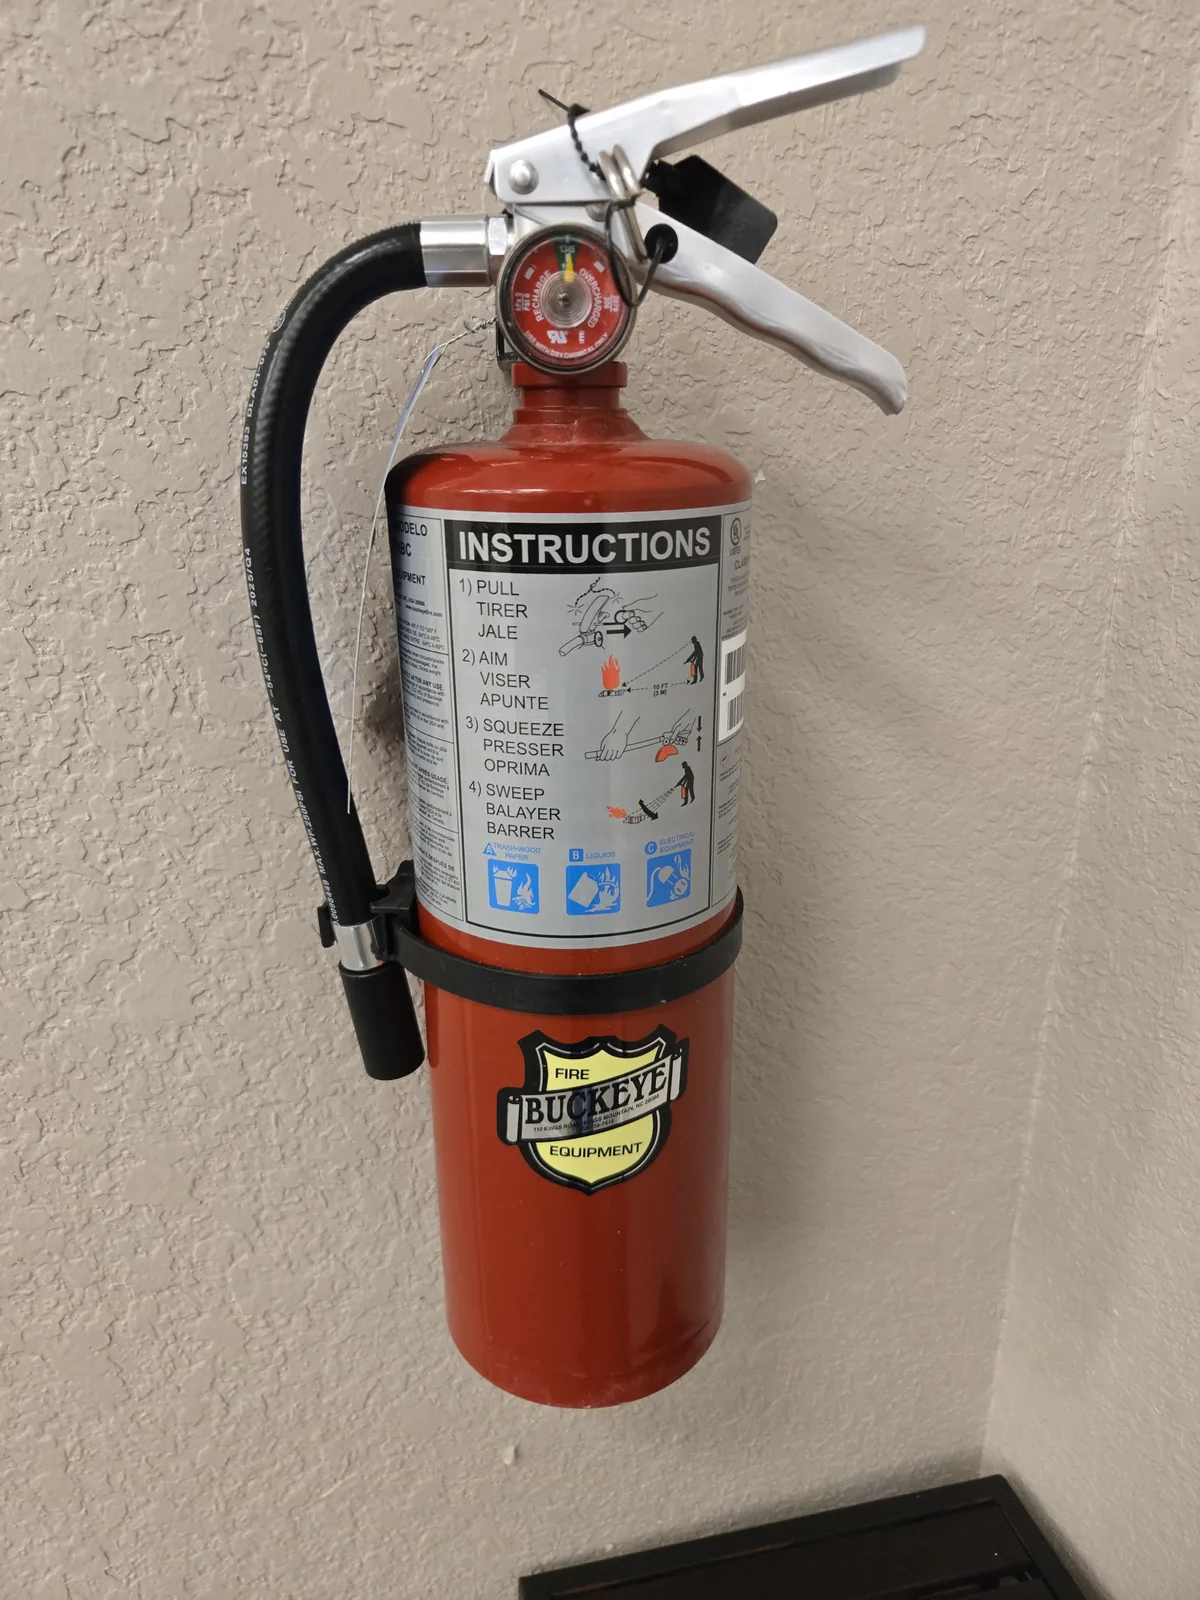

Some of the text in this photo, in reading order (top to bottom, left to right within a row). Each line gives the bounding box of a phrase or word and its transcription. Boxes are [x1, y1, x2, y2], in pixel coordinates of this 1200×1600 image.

[532, 270, 552, 322] RECHARGE
[579, 268, 602, 328] OVERCHARGED
[536, 341, 550, 354] WITH
[551, 350, 564, 358] DRY
[564, 346, 595, 358] CHEMICAL
[595, 332, 608, 348] ONLY
[241, 426, 250, 485] EX15393
[459, 526, 710, 564] INSTRUCTIONS
[244, 548, 258, 607] 2025/Q4
[459, 578, 519, 596] 1) PULL
[476, 601, 528, 618] TIRER
[478, 624, 518, 640] JALE
[462, 649, 508, 666] 2) AIM
[480, 671, 530, 688] VISER
[480, 693, 549, 710] APUNTE
[272, 704, 282, 722] AT
[466, 716, 564, 737] 3) SQUEEZE
[278, 728, 290, 752] USE
[484, 738, 564, 757] PRESSER
[287, 760, 299, 784] FOR
[484, 758, 550, 776] OPRIMA
[469, 781, 544, 801] 4) SWEEP
[486, 802, 561, 821] BALAYER
[295, 790, 326, 874] MAX.WP.250PSI
[487, 821, 555, 840] BARRER
[660, 832, 696, 845] ELECTRICAL
[573, 851, 579, 859] B
[586, 851, 616, 859] LIQUIDS
[660, 839, 694, 853] EQUIPMENT
[555, 1068, 590, 1080] FIRE
[525, 1063, 667, 1124] BUCKEYE
[549, 1142, 642, 1158] EQUIPMENT
